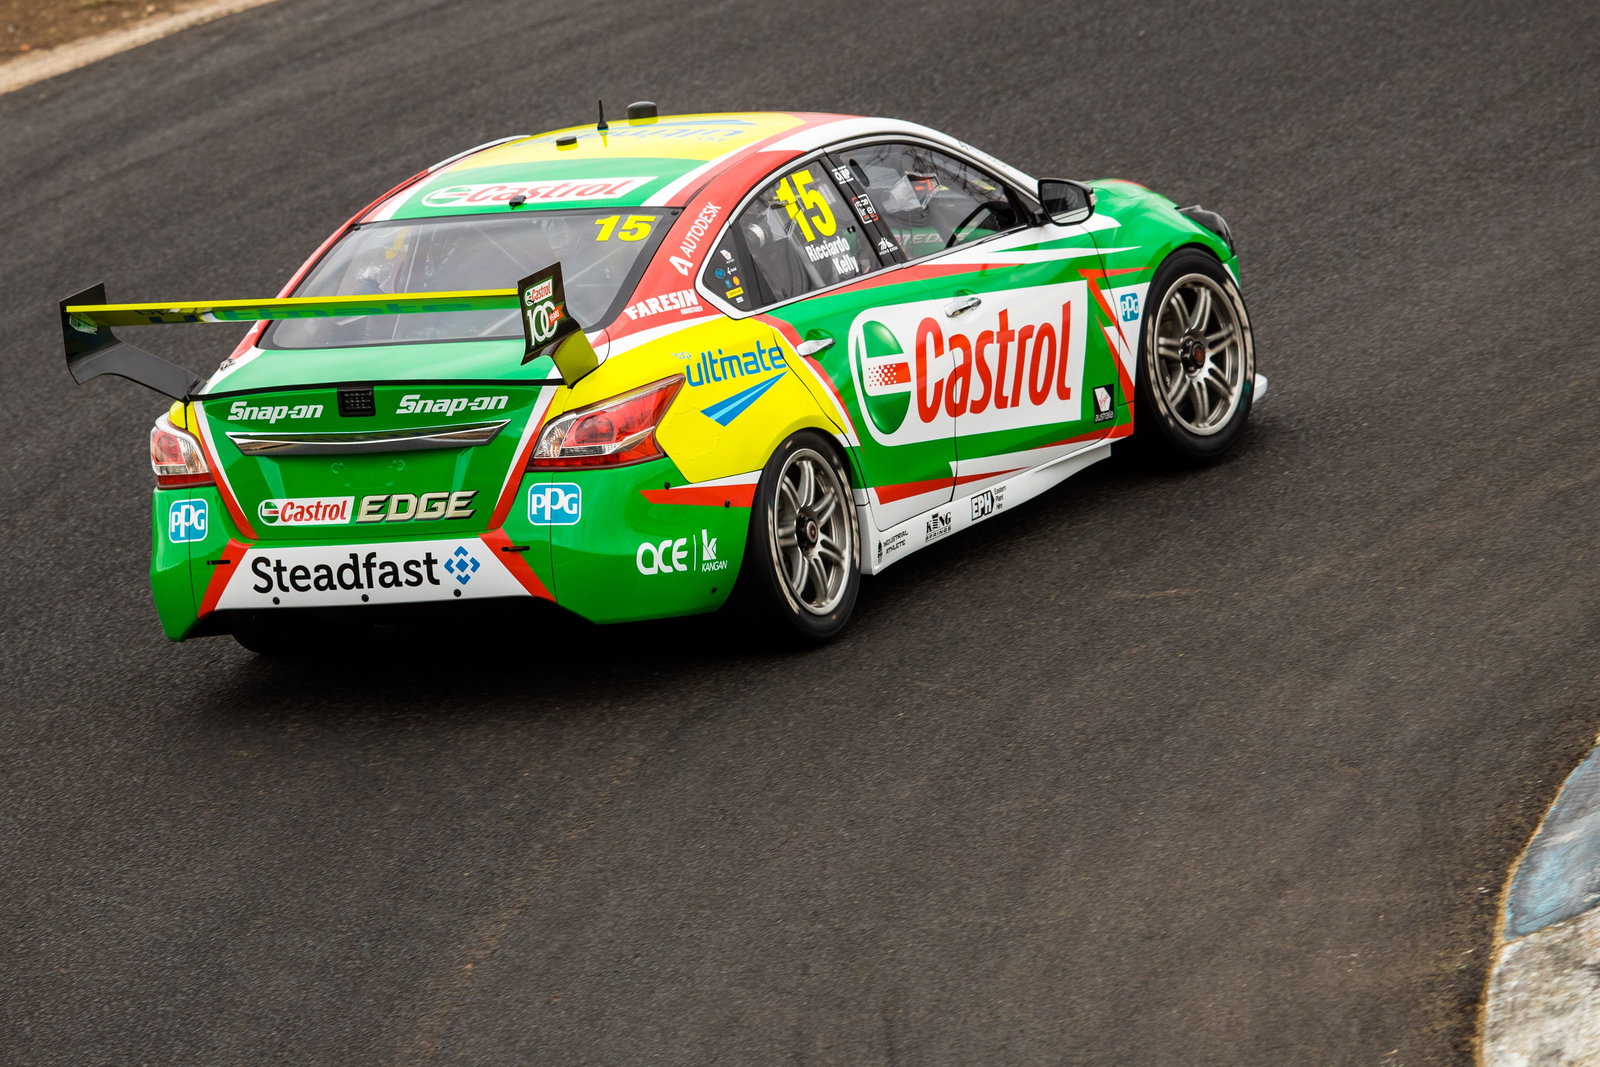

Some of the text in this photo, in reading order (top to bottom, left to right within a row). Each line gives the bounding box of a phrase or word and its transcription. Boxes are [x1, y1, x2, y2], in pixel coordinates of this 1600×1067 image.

[469, 180, 634, 203] Castrol
[775, 169, 838, 243] 15
[594, 215, 657, 242] 15
[680, 201, 722, 258] AUTODESK
[804, 235, 850, 263] Ricciardo
[832, 254, 859, 275] Kelly
[531, 282, 552, 302] Castrol
[623, 289, 699, 321] FARESIN
[1121, 295, 1140, 321] PPG
[526, 300, 559, 347] 100
[685, 340, 788, 388] ultimate
[915, 301, 1072, 425] Castrol
[228, 401, 325, 424] Snap-on
[396, 393, 509, 417] Snap-on
[1094, 410, 1114, 422] australia
[280, 489, 480, 525] Castrol EDGE
[531, 487, 578, 521] PPG
[972, 492, 994, 520] EPH
[170, 504, 207, 538] PPG
[251, 550, 441, 594] Steadfast
[701, 560, 728, 573] KANGAN
